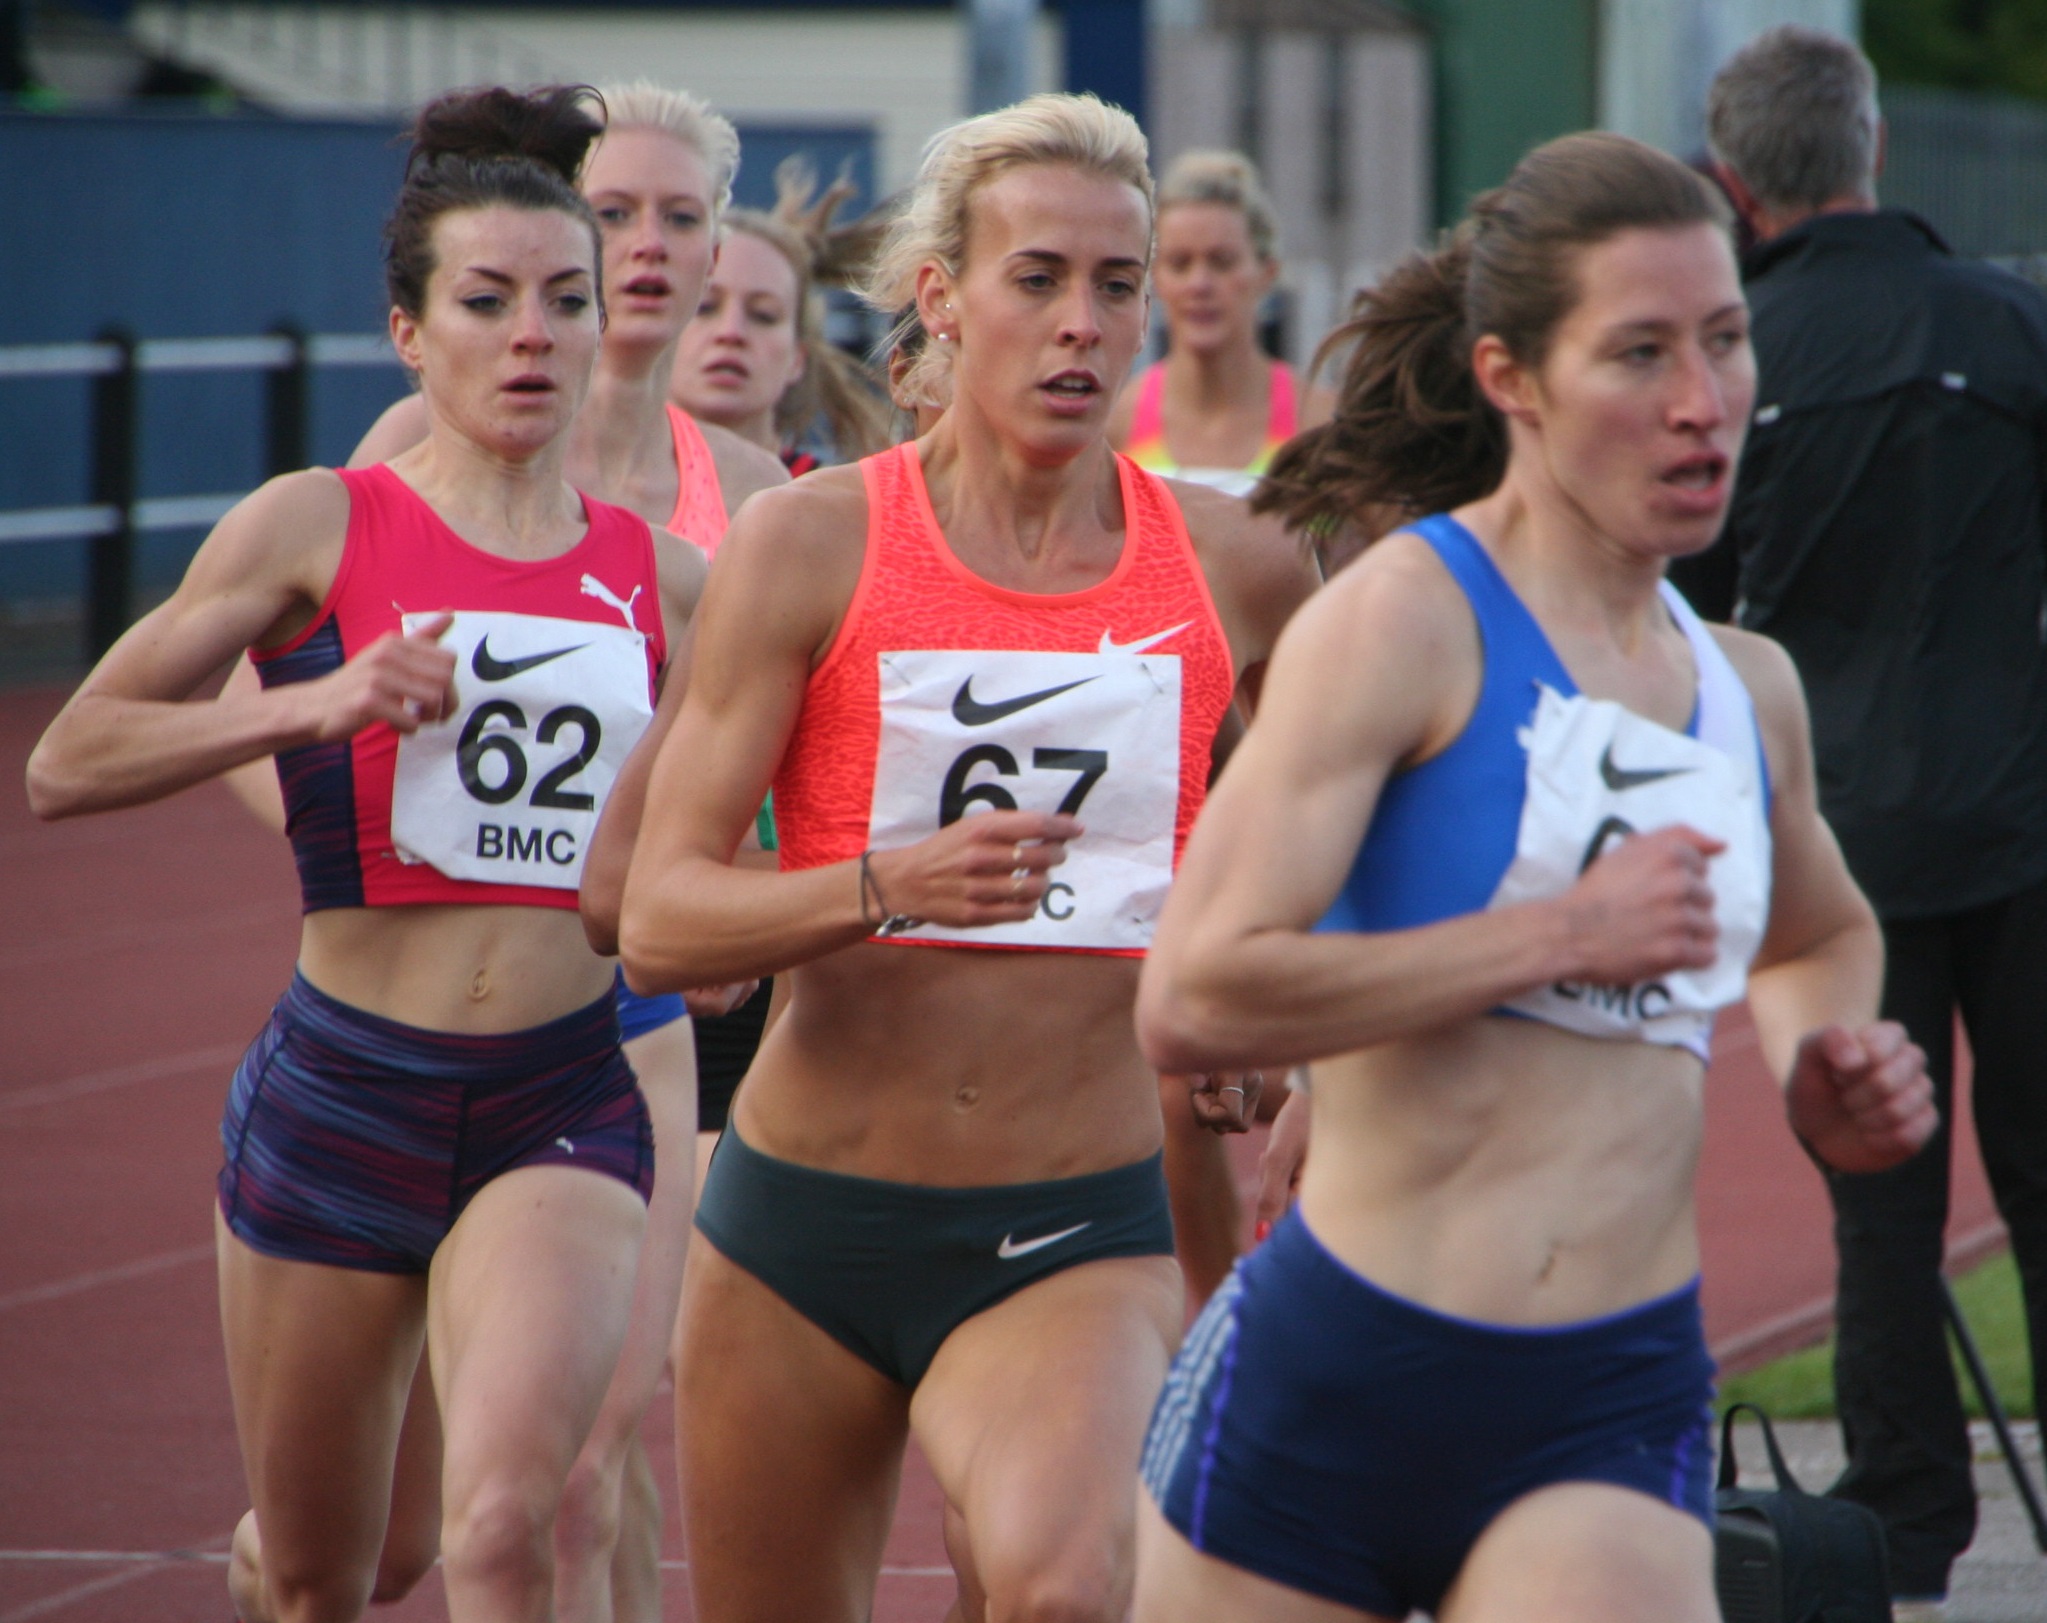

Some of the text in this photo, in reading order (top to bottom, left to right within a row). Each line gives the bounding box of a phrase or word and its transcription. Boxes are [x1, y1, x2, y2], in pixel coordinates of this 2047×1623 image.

[456, 698, 602, 812] 62
[939, 743, 1108, 830] 67
[476, 823, 576, 865] BMC
